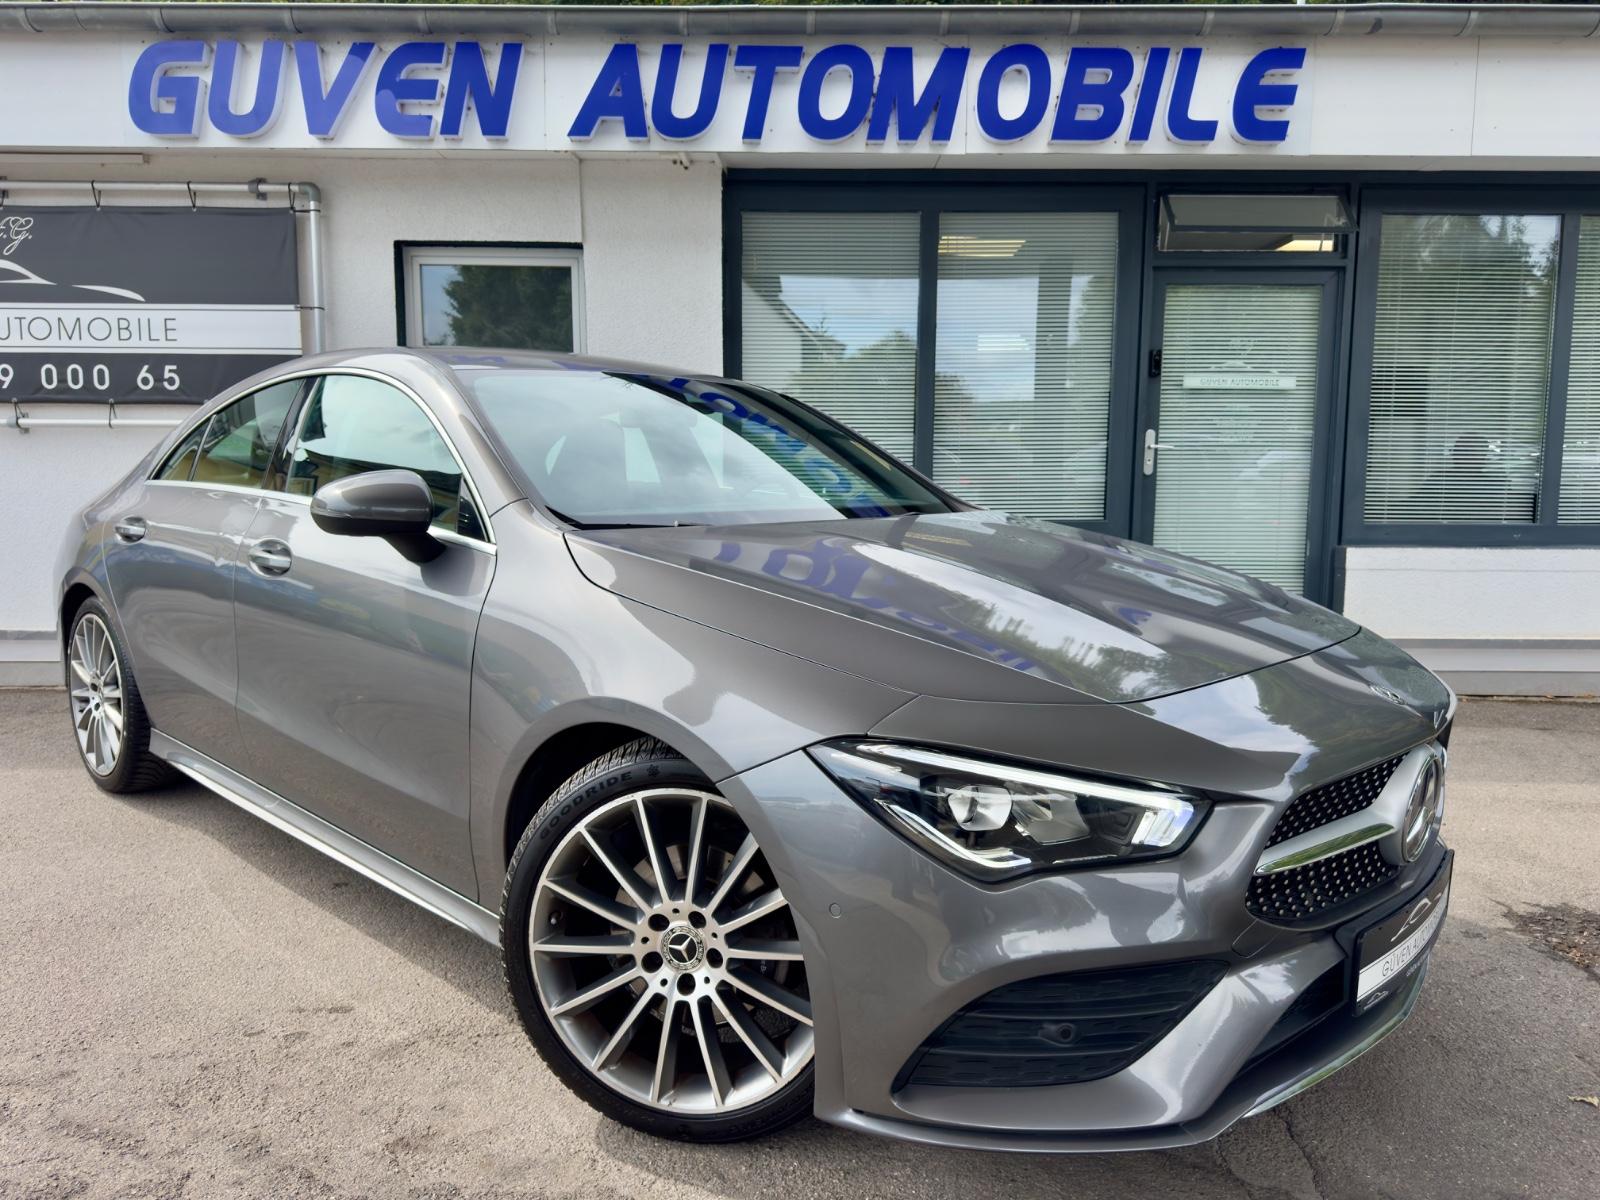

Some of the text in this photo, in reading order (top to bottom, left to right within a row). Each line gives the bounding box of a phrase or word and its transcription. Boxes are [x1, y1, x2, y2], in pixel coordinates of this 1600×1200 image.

[129, 40, 1307, 144] GUVEN AUTOMOBILE
[40, 363, 110, 390] 000
[136, 364, 181, 391] 65
[539, 771, 633, 841] GOODRIDE
